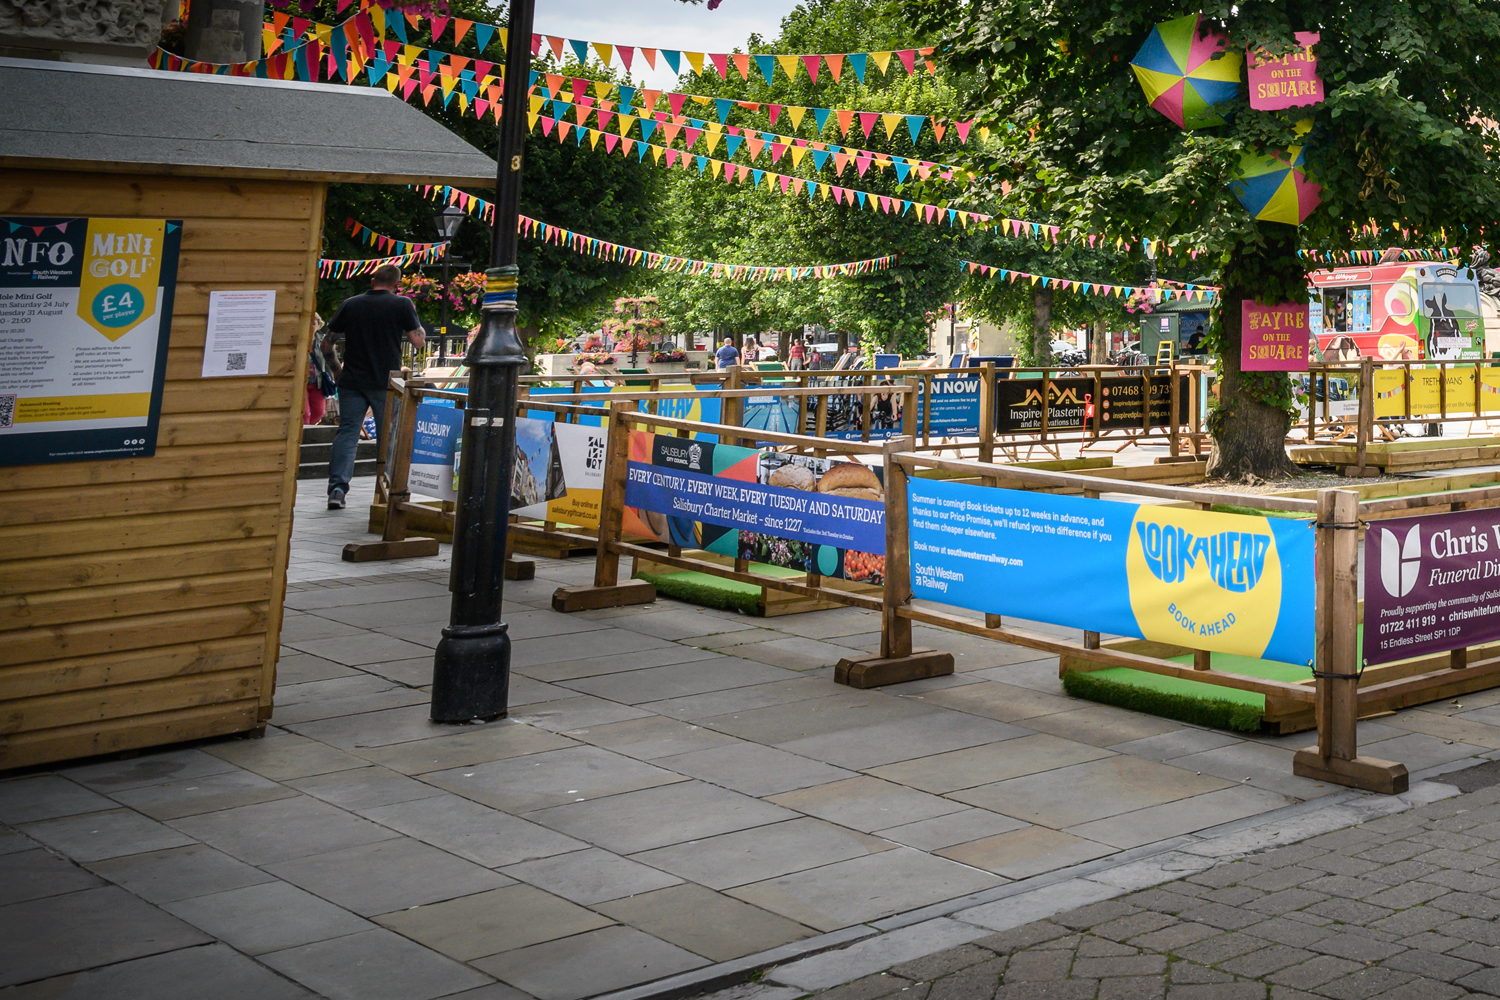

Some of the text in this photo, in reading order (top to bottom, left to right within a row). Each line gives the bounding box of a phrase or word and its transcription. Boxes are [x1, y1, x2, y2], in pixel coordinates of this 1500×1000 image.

[1271, 69, 1301, 78] ON THE
[1258, 80, 1317, 98] SQUARE
[511, 155, 520, 170] 3
[0, 237, 74, 266] NFO
[91, 233, 153, 257] MINI
[89, 257, 155, 278] GOLF
[102, 292, 133, 312] £4
[115, 310, 136, 318] player
[1248, 311, 1305, 330] FAYRE
[1263, 333, 1290, 341] ON THE
[1249, 344, 1303, 360] SQUARE
[943, 381, 978, 394] NOW
[1112, 385, 1139, 396] 07468
[1048, 407, 1088, 418] Plasterin
[1087, 406, 1092, 416] 4
[417, 421, 451, 437] SALISBURY
[1033, 418, 1069, 427] Revations
[421, 436, 442, 447] GIFT CARD
[661, 445, 689, 458] SALISBURY
[629, 468, 653, 485] EVERY
[653, 472, 686, 493] CENTURY,
[687, 479, 714, 496] EVERY
[715, 484, 739, 502] WEEK,
[740, 488, 767, 505] EVERY
[769, 495, 808, 512] TUESDAY
[809, 501, 831, 516] AND
[552, 507, 597, 519] salisburygiftcard.co.uk
[572, 499, 593, 509] Buy online
[912, 493, 1105, 527] Summer is coming! Book tickets up to 12 weeks in advance, and
[673, 497, 803, 532] Salisbury Charter Market since 1227
[912, 506, 931, 517] thanks
[932, 509, 939, 517] to
[950, 511, 965, 522] Price
[966, 514, 993, 527] Promise,
[993, 518, 1007, 528] we'll
[1009, 521, 1030, 531] refund
[1031, 524, 1043, 533] you
[1044, 525, 1055, 534] the
[1056, 526, 1091, 539] difference
[1099, 532, 1112, 542] you
[913, 519, 997, 539] find them cheaper elsewhere.
[1430, 525, 1489, 559] Chris
[914, 541, 928, 551] Book
[928, 544, 939, 553] now
[947, 548, 1023, 566] southwesternrailway.com
[1136, 521, 1271, 593] LOOK AHEAD
[915, 562, 964, 582] South Western
[1428, 561, 1481, 587] Funeral
[922, 576, 948, 593] Railway
[1380, 606, 1405, 618] Proudly
[1405, 600, 1437, 615] supporting
[1437, 599, 1447, 608] the
[1447, 594, 1479, 606] community
[1479, 591, 1486, 602] of
[1167, 602, 1236, 636] BOOK AHEAD
[1379, 620, 1404, 634] 01722
[1406, 617, 1420, 630] 411
[1422, 615, 1436, 628] 919
[1380, 626, 1461, 649] 15 Endless Street SP1 1DP
